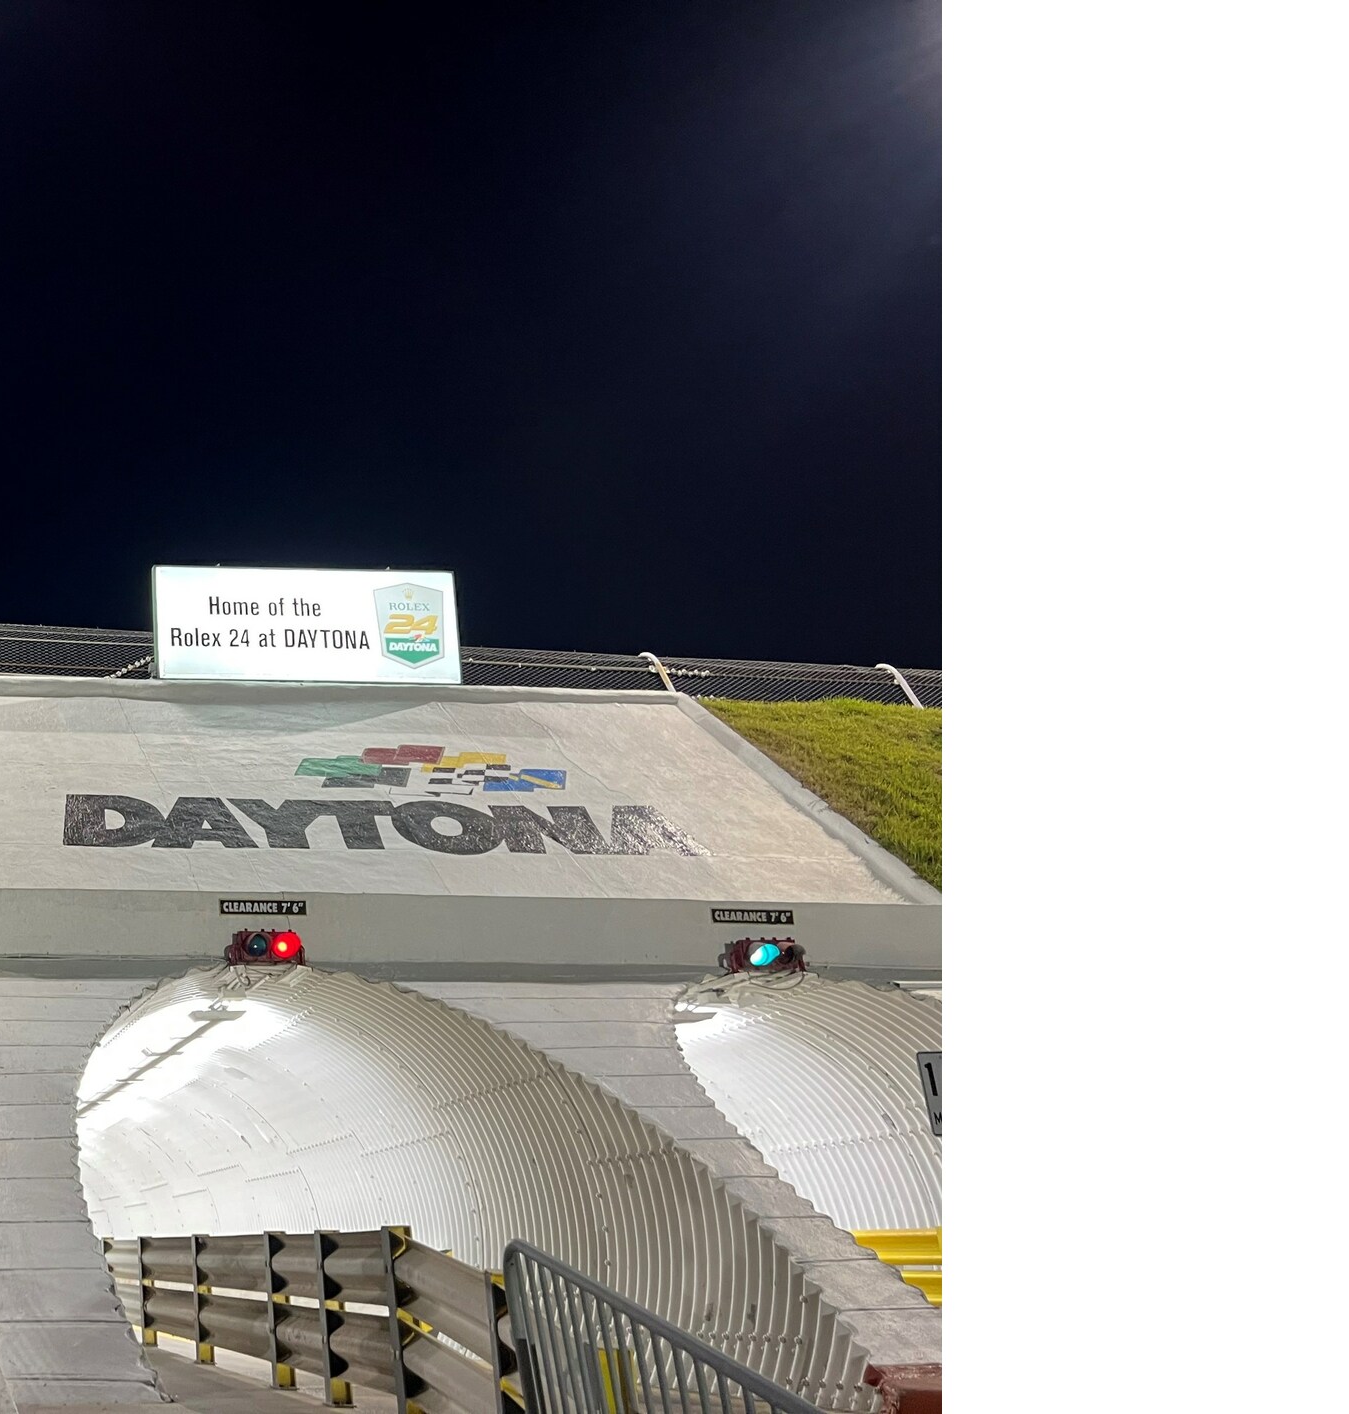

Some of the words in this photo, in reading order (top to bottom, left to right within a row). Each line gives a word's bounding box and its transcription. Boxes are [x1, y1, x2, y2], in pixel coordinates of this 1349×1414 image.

[208, 596, 260, 616] Home
[268, 597, 285, 616] of
[292, 597, 322, 617] the
[389, 602, 430, 612] ROLEX
[383, 613, 439, 635] 24
[170, 627, 222, 647] Rolex
[229, 628, 250, 648] 24
[258, 628, 277, 648] at
[284, 628, 371, 650] DAYTONA
[388, 641, 438, 652] DAYTONA
[62, 793, 714, 857] DAYTONA
[222, 901, 278, 913] CLEARANCE
[281, 903, 291, 913] 7'
[292, 902, 304, 914] 6"
[714, 910, 768, 922] CLEARANCE
[769, 911, 779, 922] 7'
